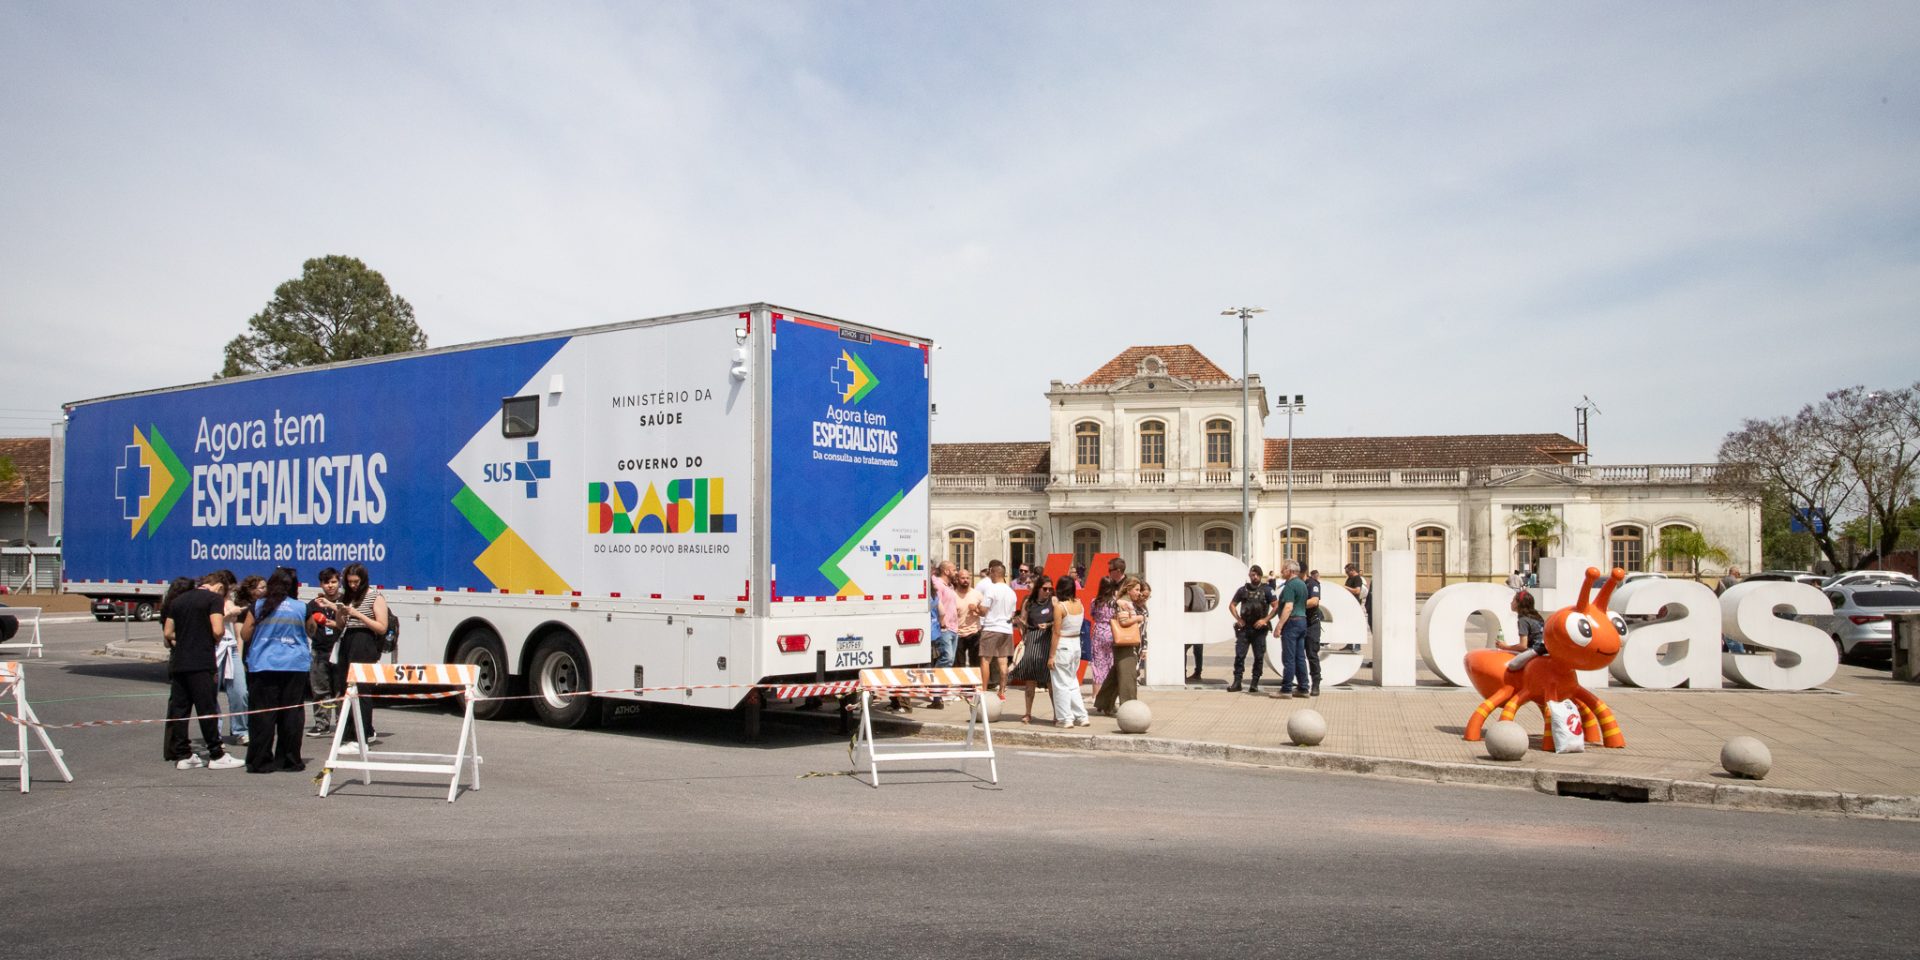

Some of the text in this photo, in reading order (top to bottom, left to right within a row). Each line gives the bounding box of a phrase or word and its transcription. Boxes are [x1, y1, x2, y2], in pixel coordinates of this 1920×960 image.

[612, 388, 712, 408] MINISTÉRIO DA
[639, 410, 683, 427] SAÚDE
[826, 405, 887, 426] Agora tem
[195, 409, 326, 462] Agora tem
[812, 421, 898, 455] ESPECIALISTAS
[617, 456, 703, 471] GOVERNO DO
[813, 450, 898, 467] Da consulta ao tratamento
[483, 462, 512, 482] SUS
[192, 452, 388, 527] ESPECIALISTAS
[588, 477, 737, 534] BRASIL
[1007, 509, 1038, 517] CEREST
[1512, 503, 1552, 512] PROCON
[191, 538, 386, 562] Da consulta ao tratamento
[594, 544, 730, 554] DO LADO DO POVO BRASILEIRO
[885, 554, 924, 570] BRASIL
[835, 651, 874, 667] ATHOS
[394, 665, 427, 681] STT
[906, 669, 936, 683] STT
[615, 704, 640, 716] ATHOS
